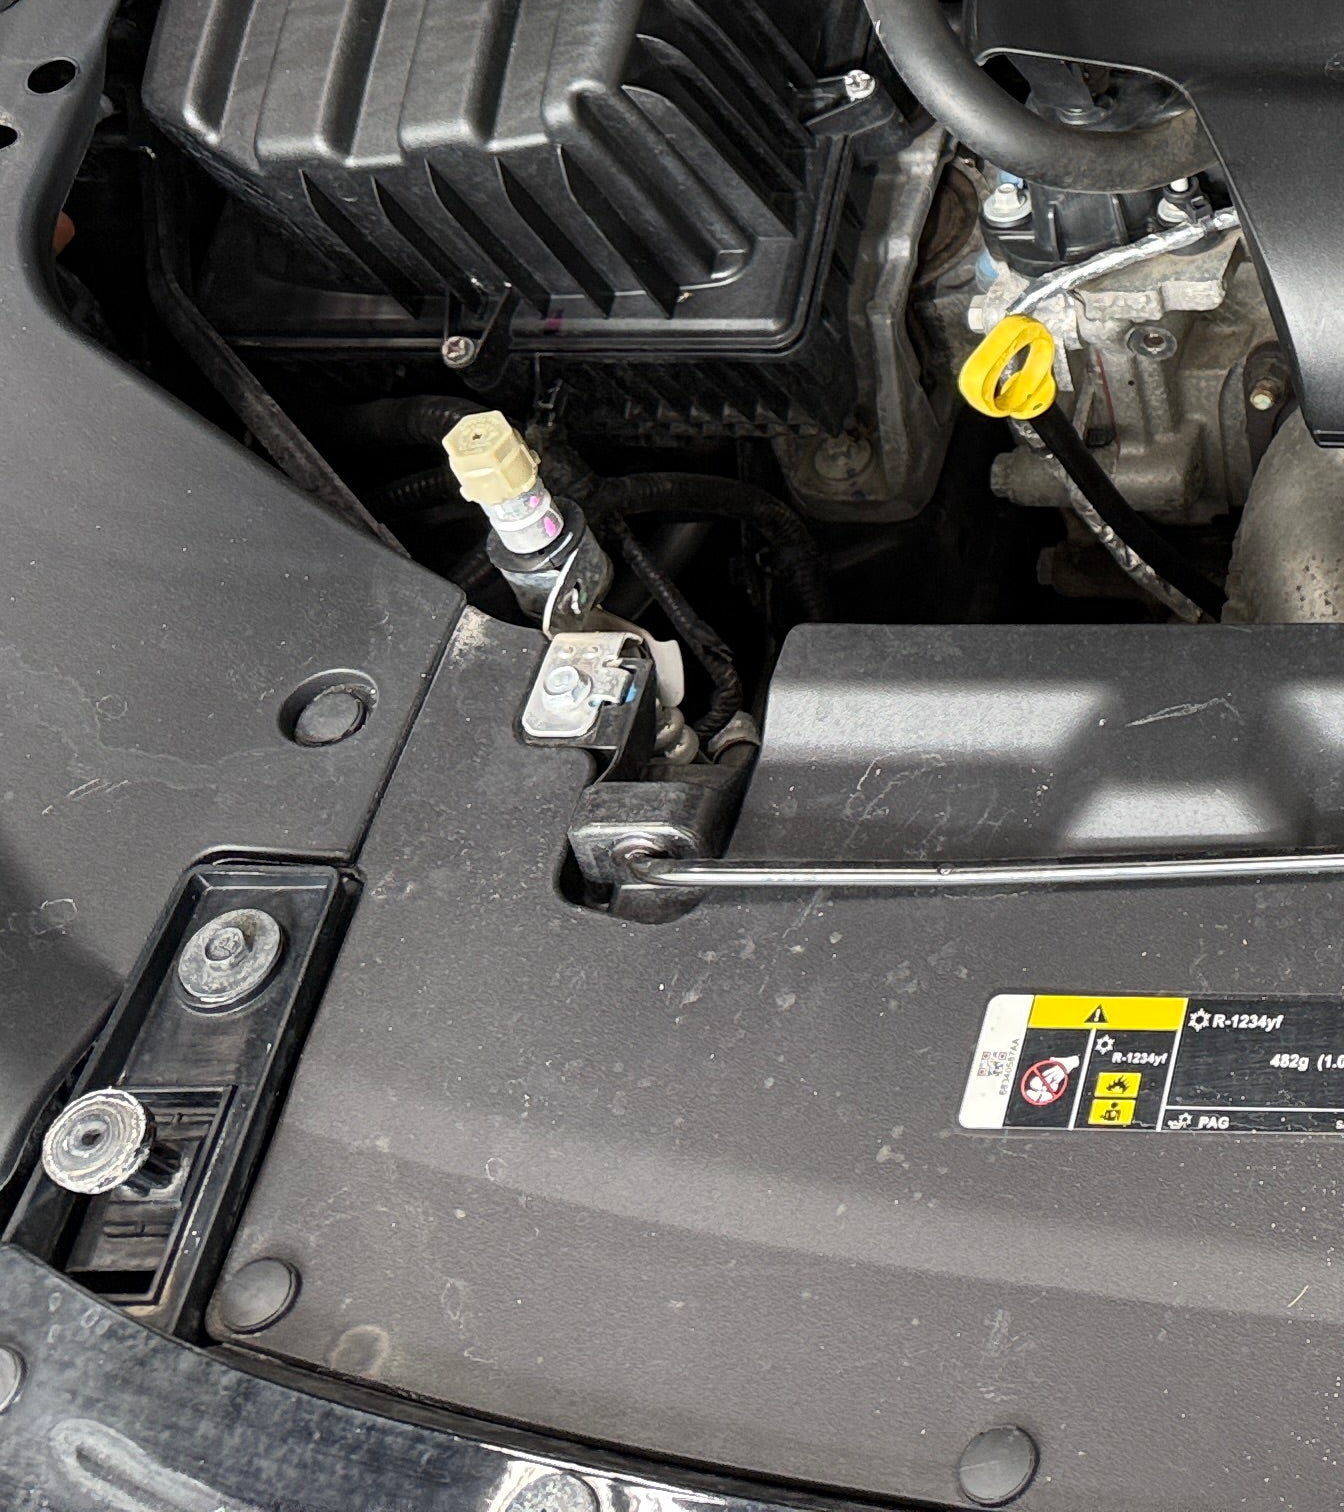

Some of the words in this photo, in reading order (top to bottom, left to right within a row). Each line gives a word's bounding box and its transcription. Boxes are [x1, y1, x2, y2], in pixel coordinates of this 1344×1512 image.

[1211, 1012, 1284, 1031] R-1234yf
[1111, 1050, 1168, 1066] R-1234yf
[1269, 1053, 1310, 1073] 482g
[1197, 1115, 1230, 1130] PAG
